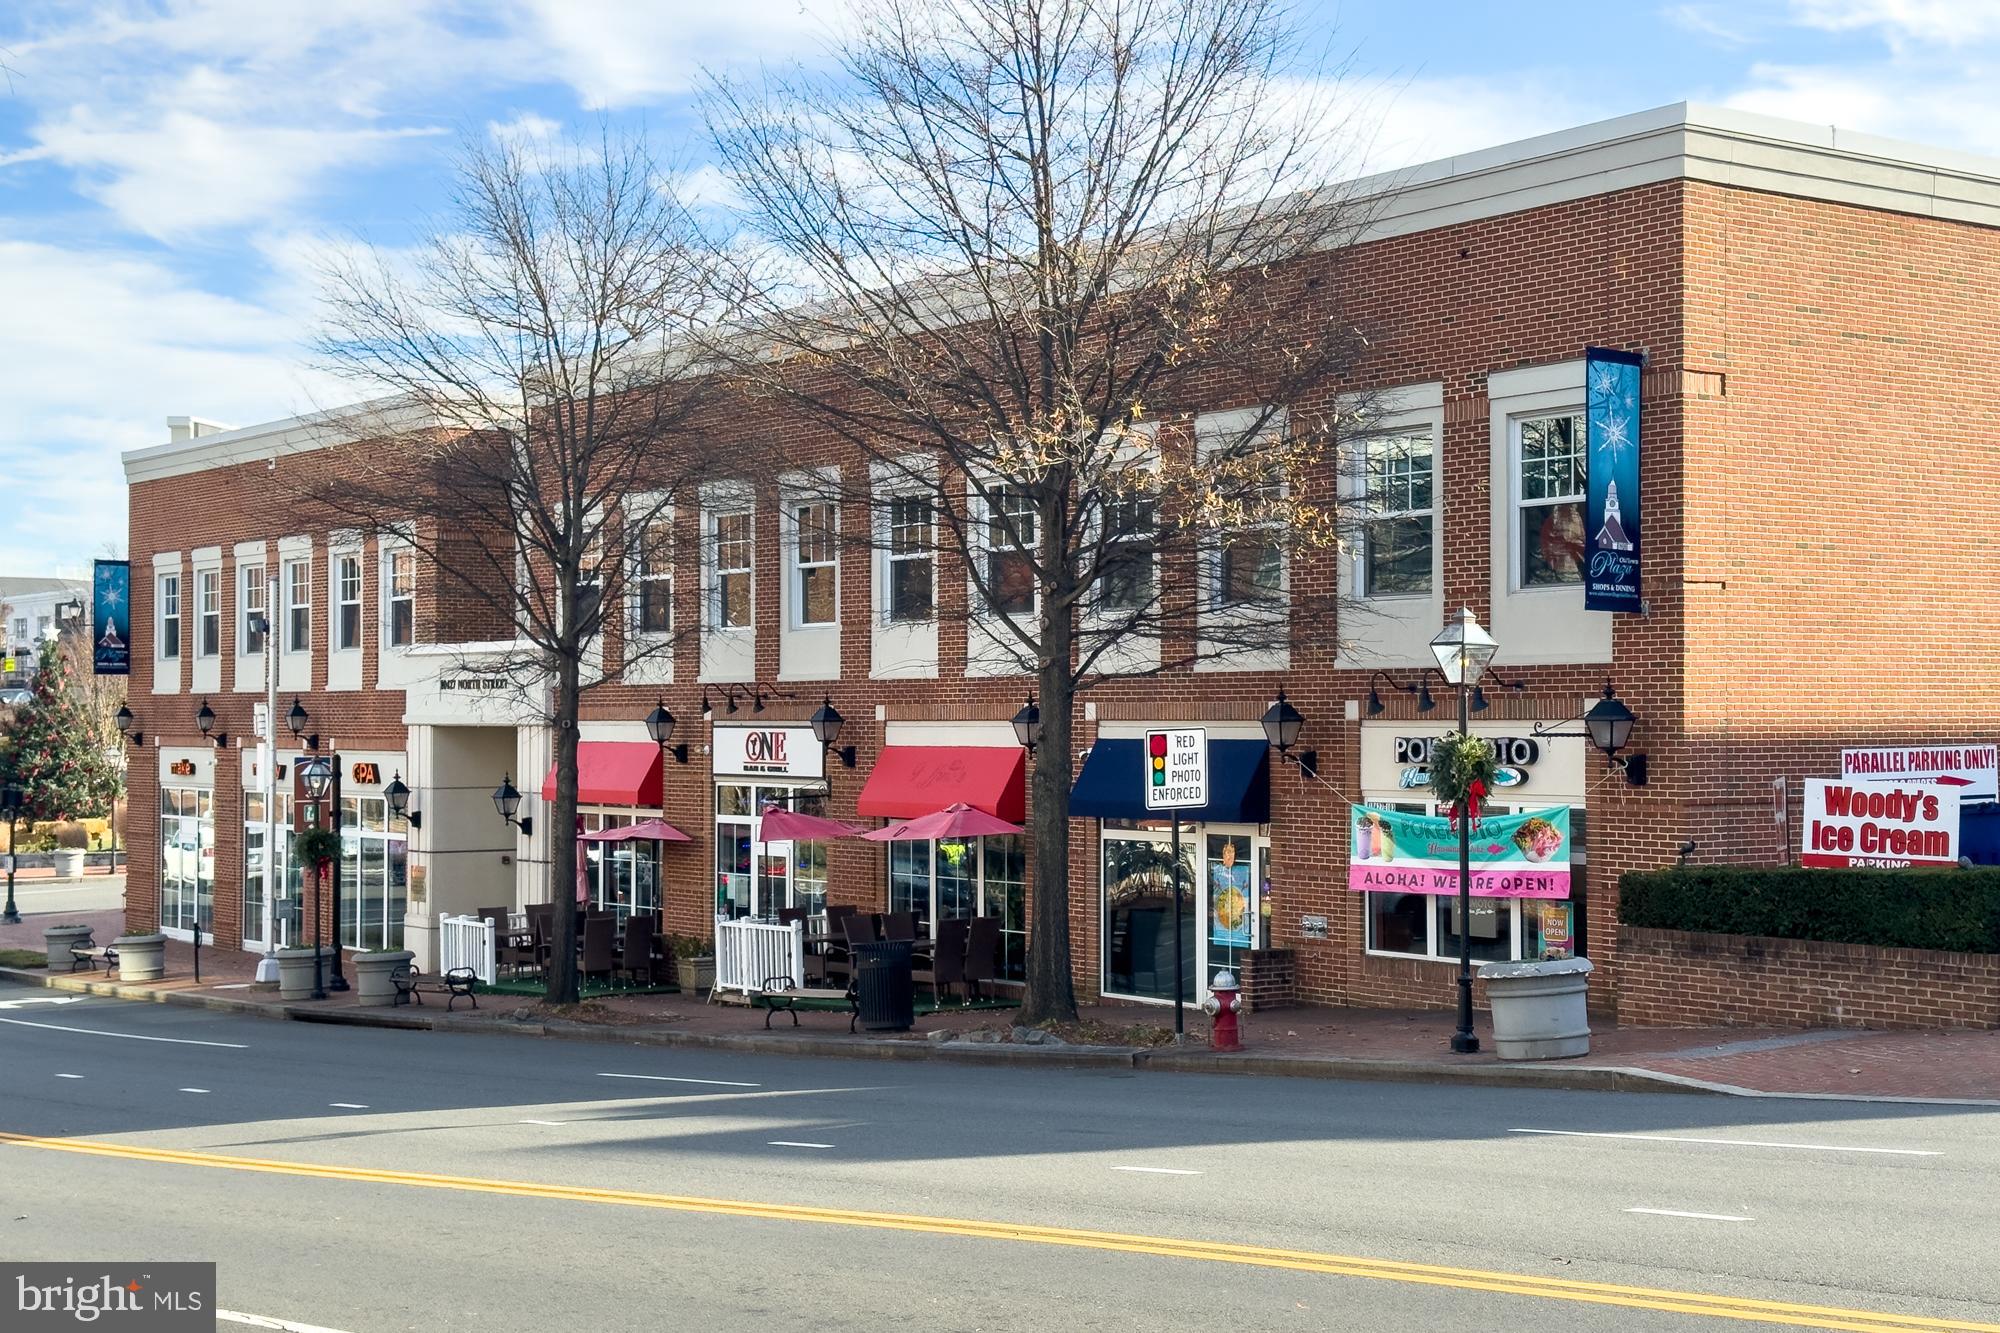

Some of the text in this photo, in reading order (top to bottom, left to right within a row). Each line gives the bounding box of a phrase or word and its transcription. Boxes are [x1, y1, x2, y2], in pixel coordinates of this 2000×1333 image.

[1590, 550, 1633, 583] Plaza
[1592, 583, 1610, 591] SHOPS
[1615, 584, 1636, 593] DINING
[458, 679, 481, 690] NORTH
[482, 679, 508, 690] STREET
[745, 731, 787, 762] ONE
[1176, 735, 1195, 748] RED
[1173, 752, 1199, 766] LIGHT
[1844, 749, 1995, 774] PARALLEL PARKING ONLY!
[352, 762, 377, 784] CPA
[1172, 769, 1201, 783] PHOTO
[1153, 787, 1201, 801] ENFORCED
[1824, 785, 1939, 823] Woody's
[1812, 820, 1950, 857] Ice Cream
[1848, 857, 1911, 869] PARKING
[1364, 871, 1425, 886] ALOHA!
[1433, 875, 1458, 889] WE
[1501, 876, 1554, 891] OPEN!
[1547, 918, 1564, 927] NOW
[1545, 927, 1566, 937] OPEN!
